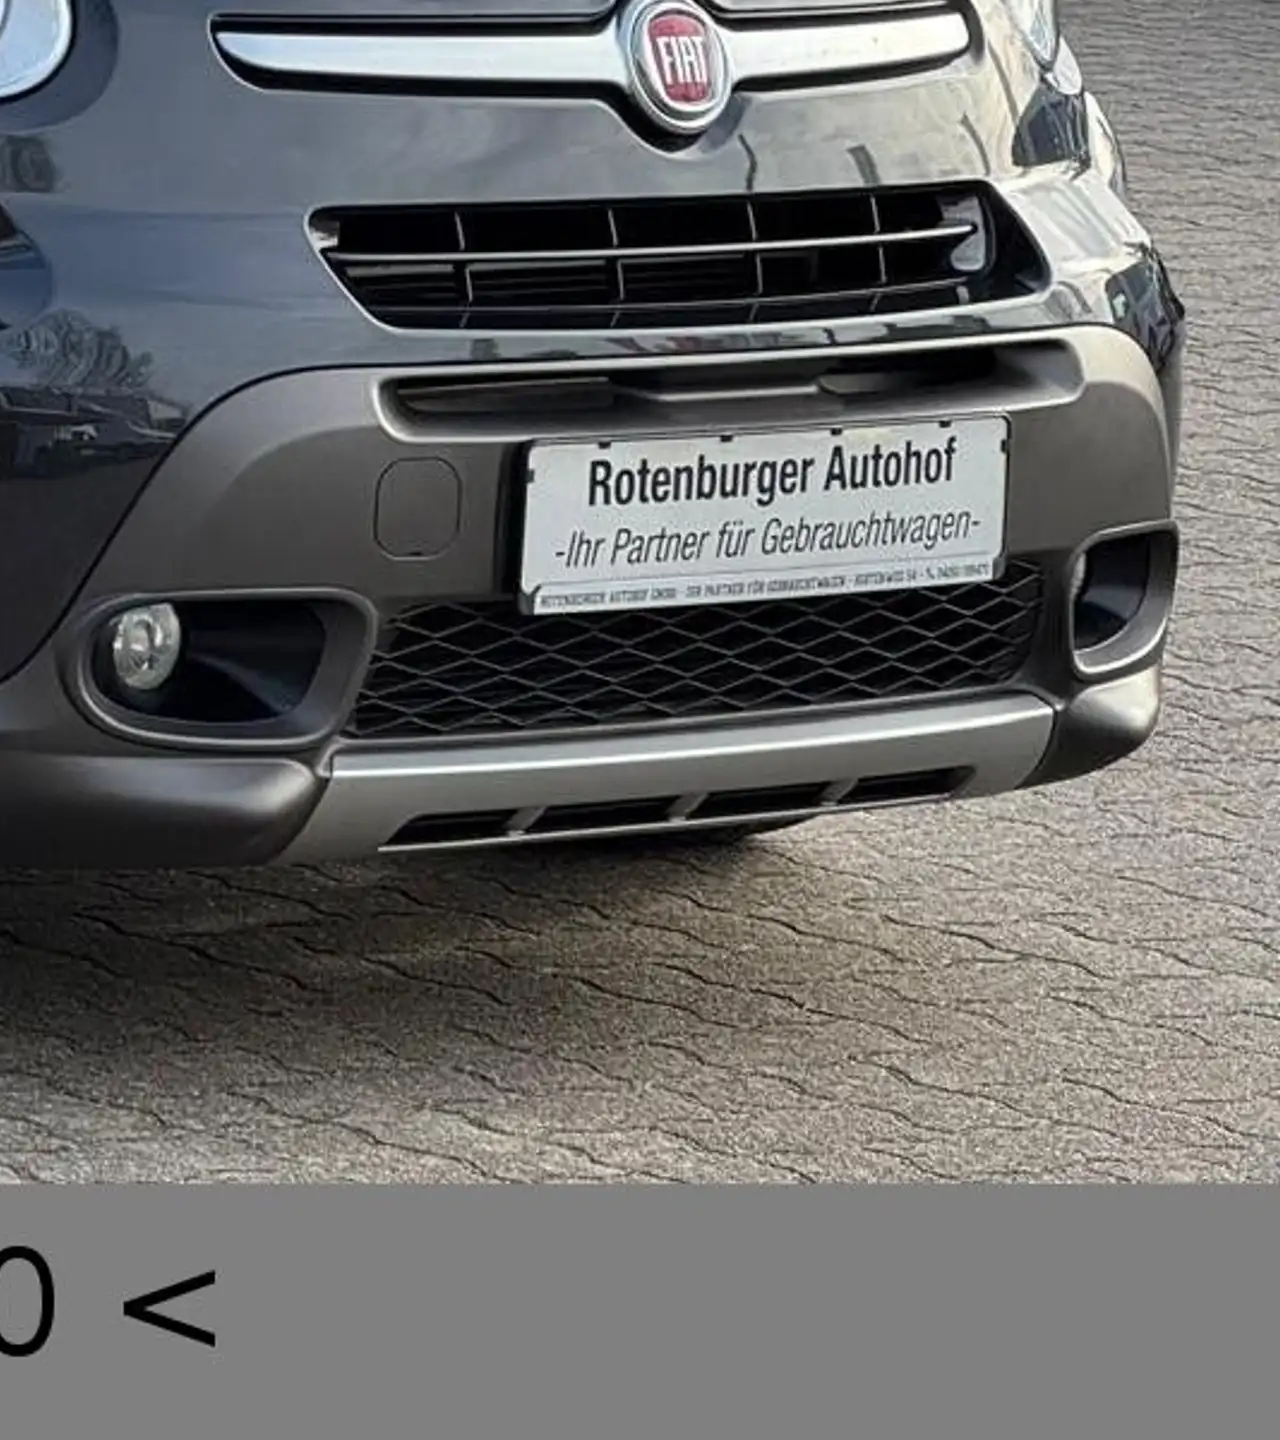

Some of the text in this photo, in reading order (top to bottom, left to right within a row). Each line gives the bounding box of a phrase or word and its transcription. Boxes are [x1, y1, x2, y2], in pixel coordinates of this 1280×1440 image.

[656, 36, 707, 85] FIAT
[588, 436, 957, 506] Rotenburger Autohof
[555, 509, 981, 567] -Ihr Partner für Gebrauchtwagen-
